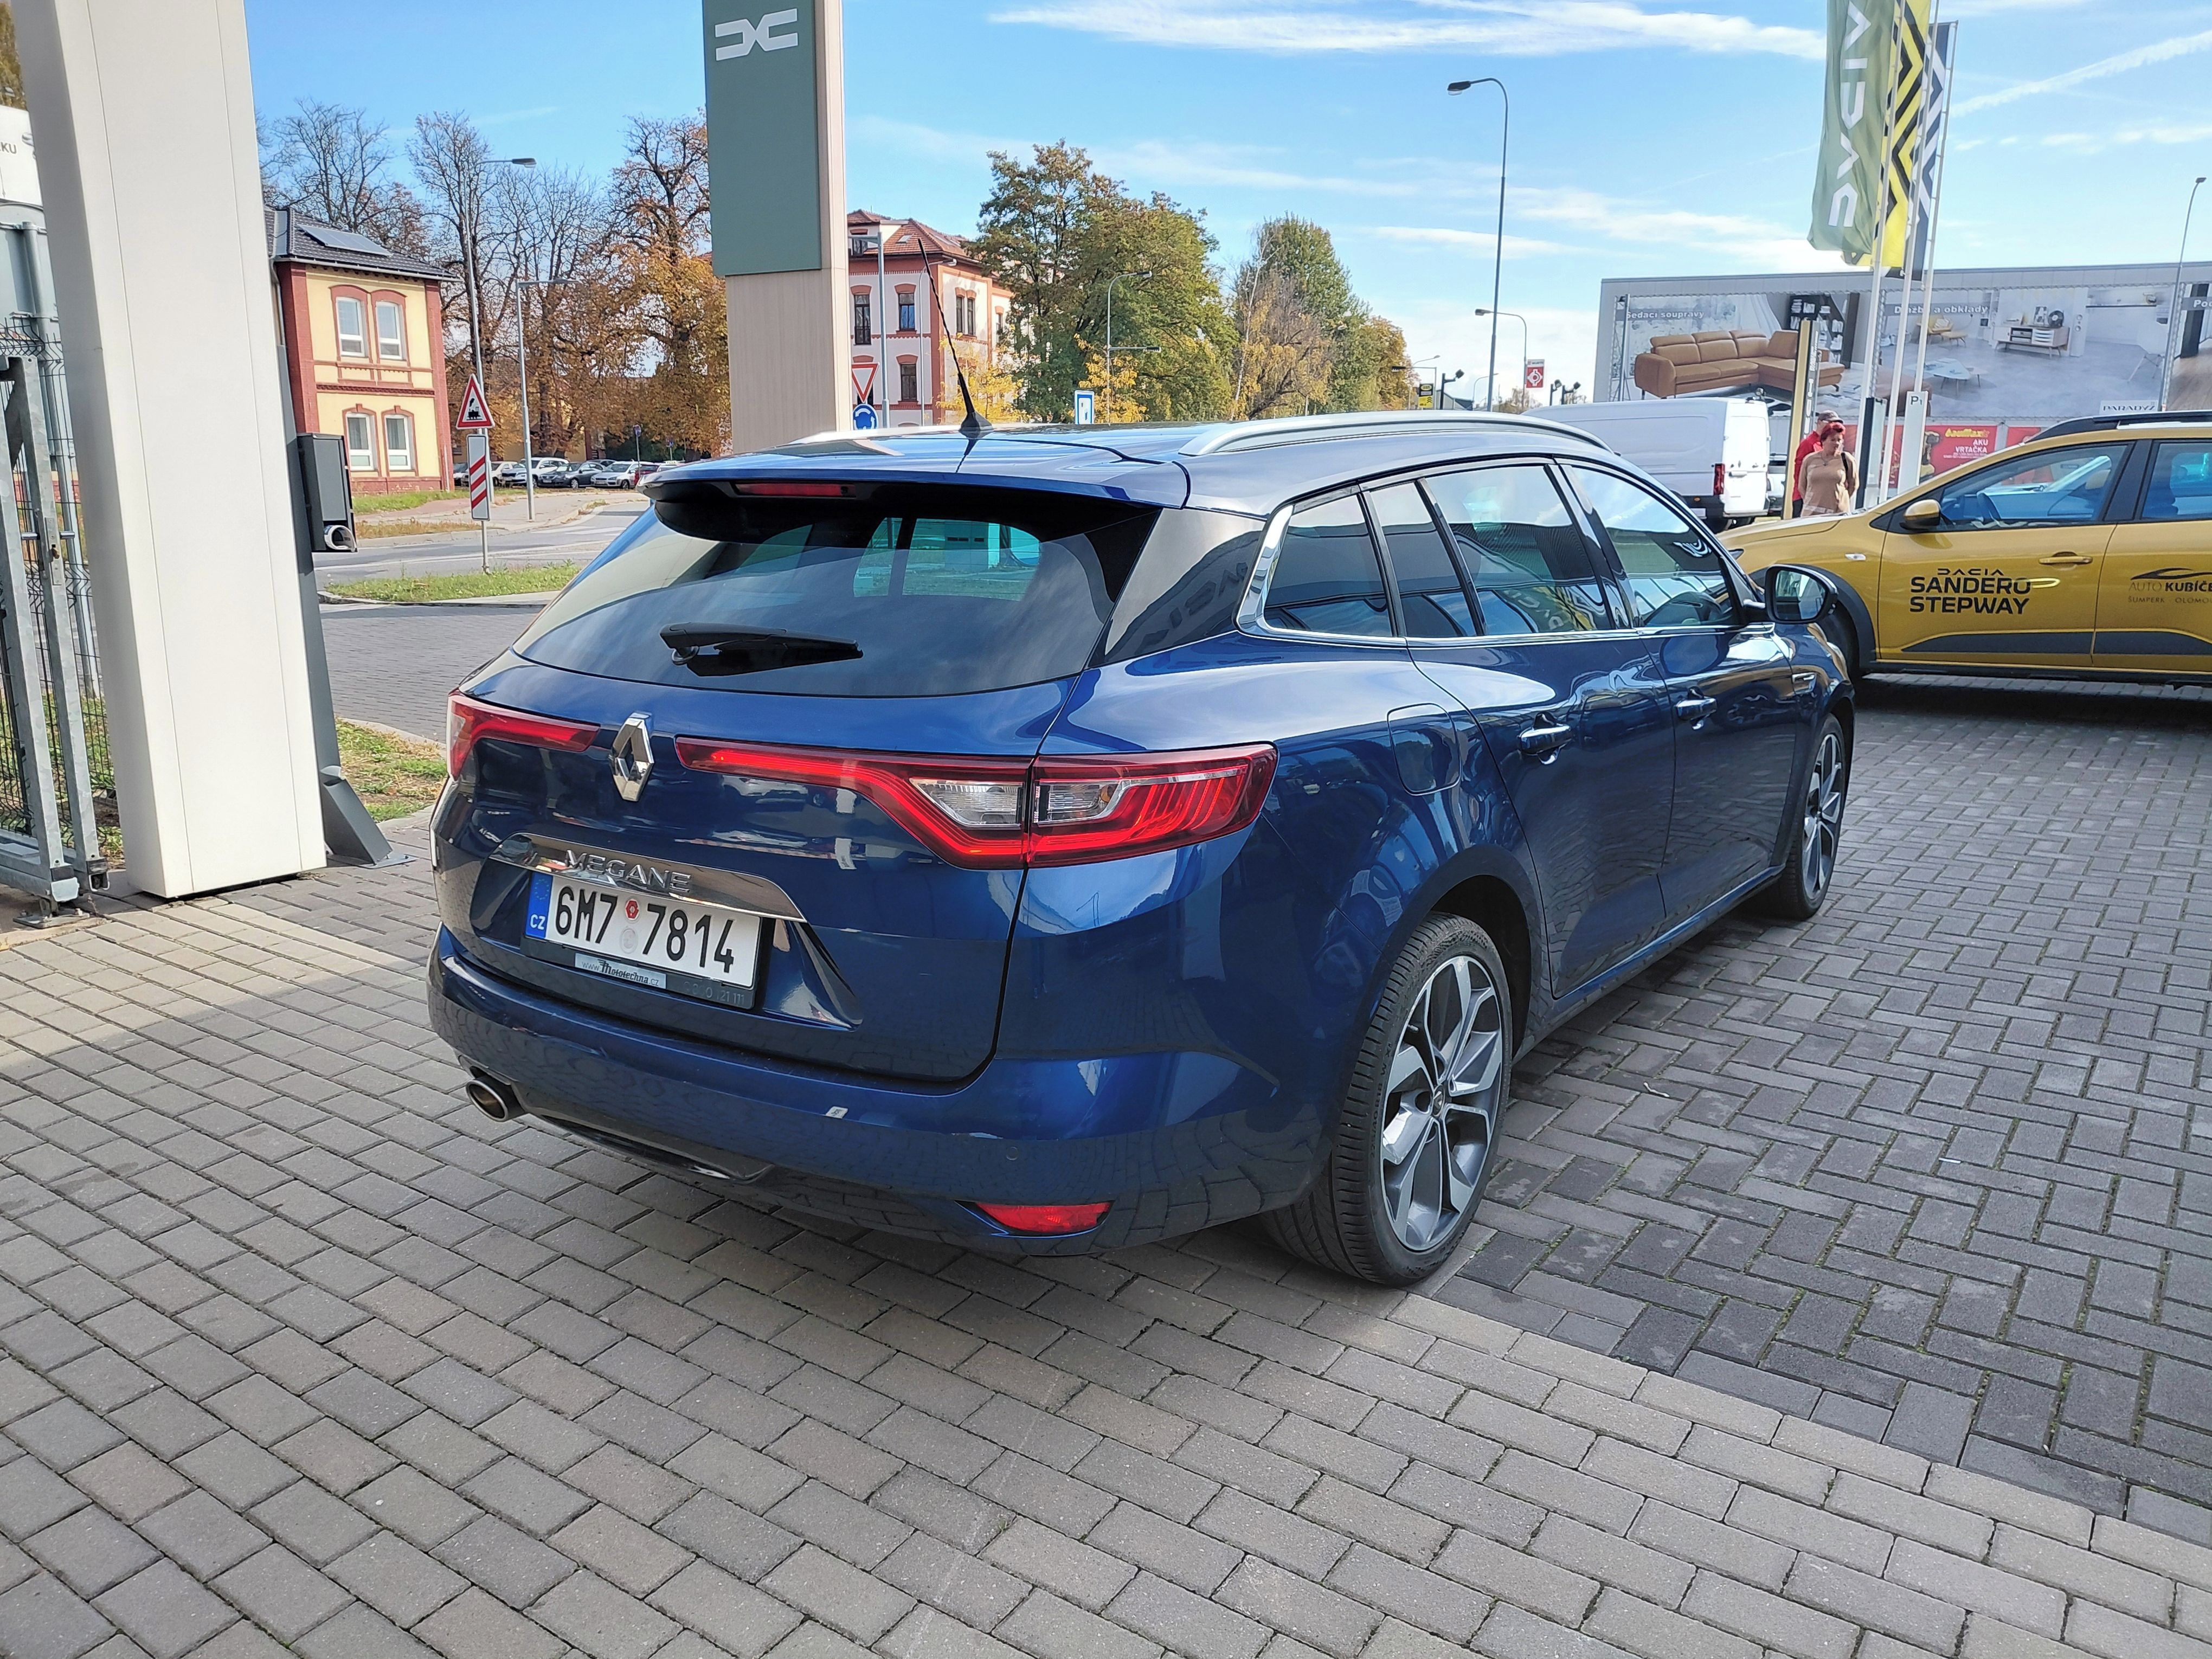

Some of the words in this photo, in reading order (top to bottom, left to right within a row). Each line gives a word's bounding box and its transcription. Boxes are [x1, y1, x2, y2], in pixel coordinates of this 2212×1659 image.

[0, 142, 17, 154] KU
[1944, 305, 1988, 314] obklady
[1911, 576, 2031, 594] SANDERO
[2129, 582, 2162, 592] AUTO
[1909, 596, 2030, 614] STEPWAY
[564, 850, 691, 892] MEGANE
[530, 914, 545, 930] CZ
[556, 886, 618, 944] 6M7
[642, 903, 734, 973] 7814
